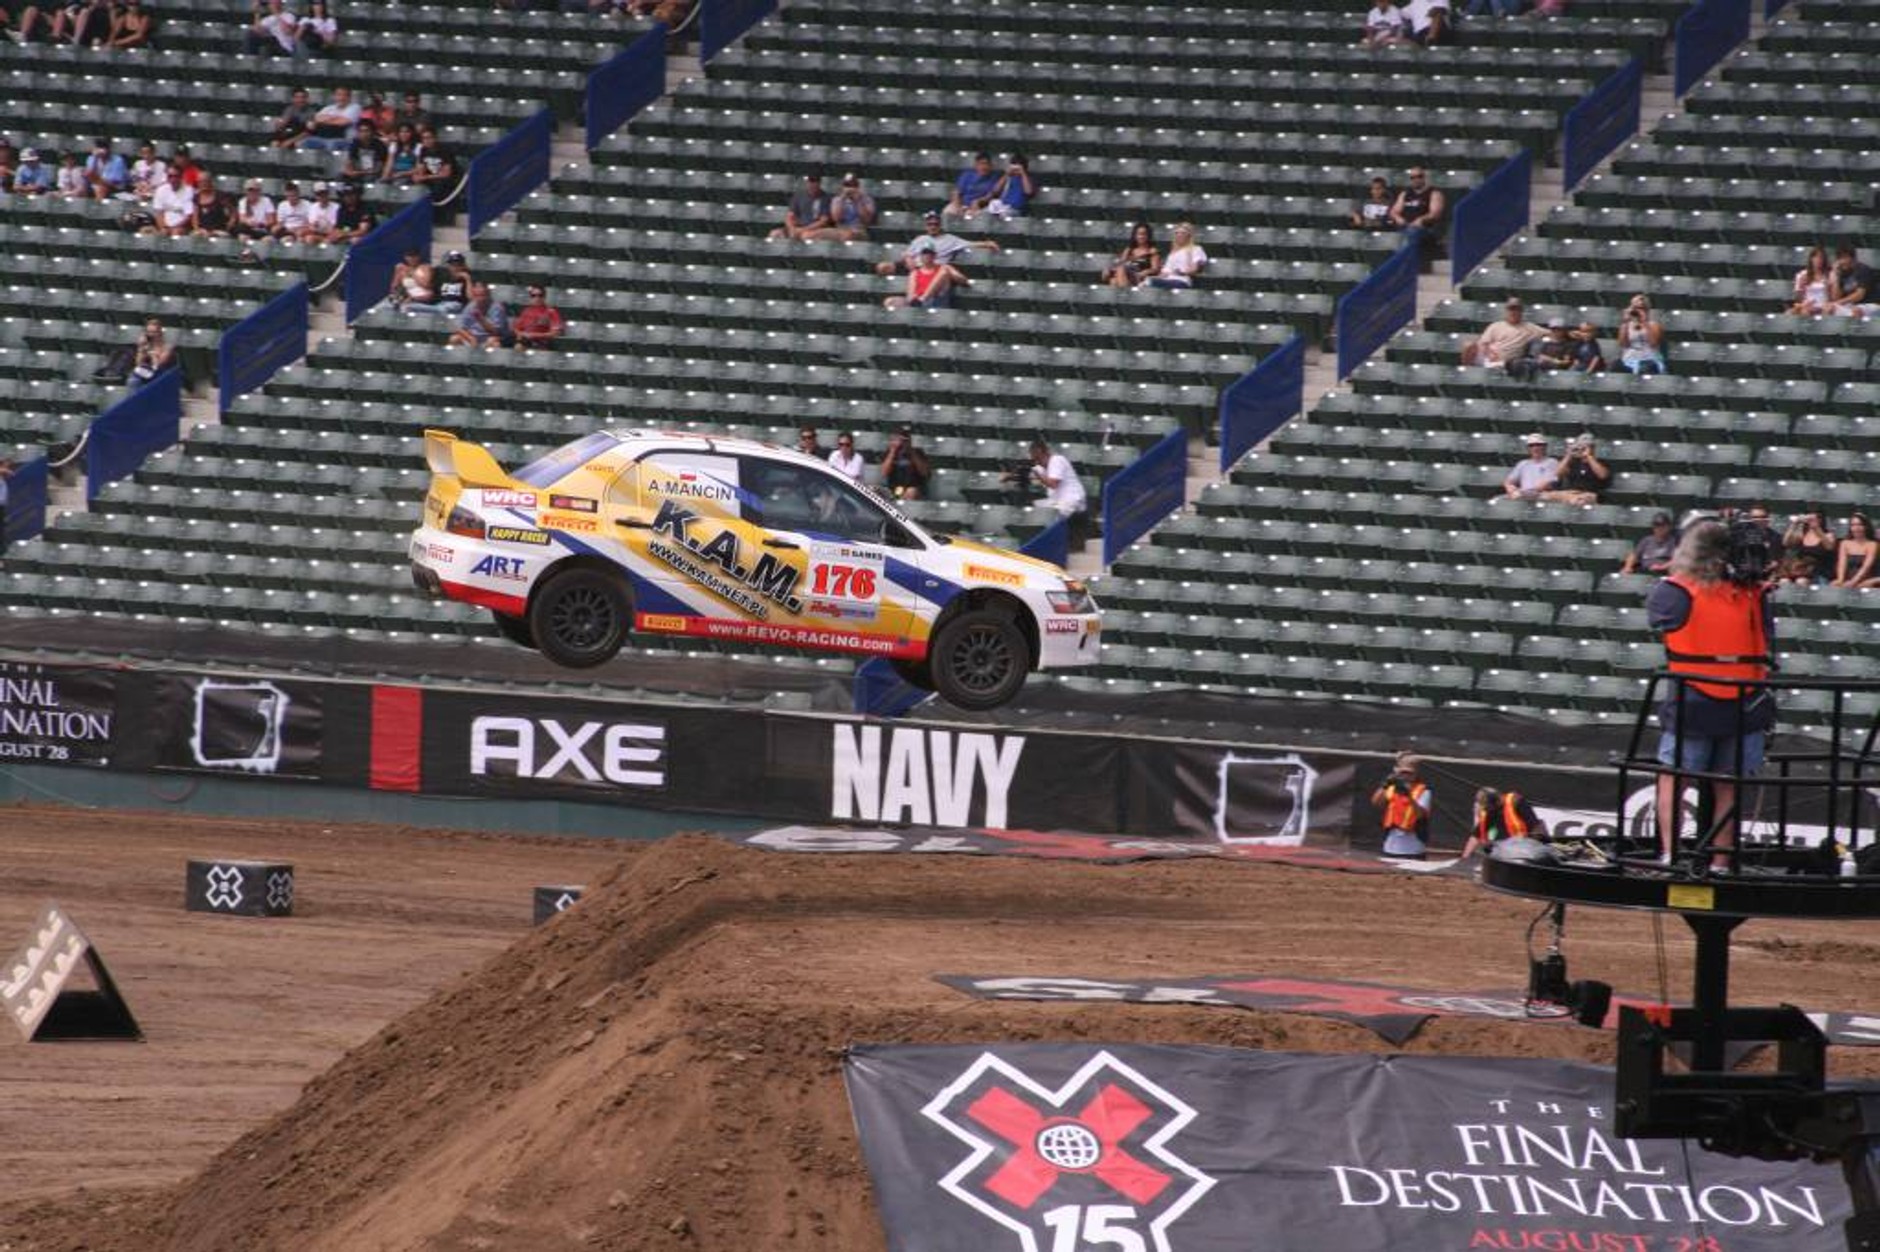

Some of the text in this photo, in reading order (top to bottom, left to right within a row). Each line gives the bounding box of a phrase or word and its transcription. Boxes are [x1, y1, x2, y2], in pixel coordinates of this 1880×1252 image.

[483, 489, 535, 504] WRC
[470, 554, 526, 577] ART
[812, 564, 876, 599] 176
[1047, 620, 1079, 633] WRC
[46, 744, 69, 759] 28
[470, 715, 665, 786] AXE
[832, 723, 1026, 829] NAVY
[1490, 1100, 1605, 1119] THE
[1453, 1124, 1664, 1175] FINAL
[1329, 1166, 1825, 1227] DESTINATION
[1043, 1204, 1147, 1252] 15
[1468, 1229, 1655, 1252] AUGUST
